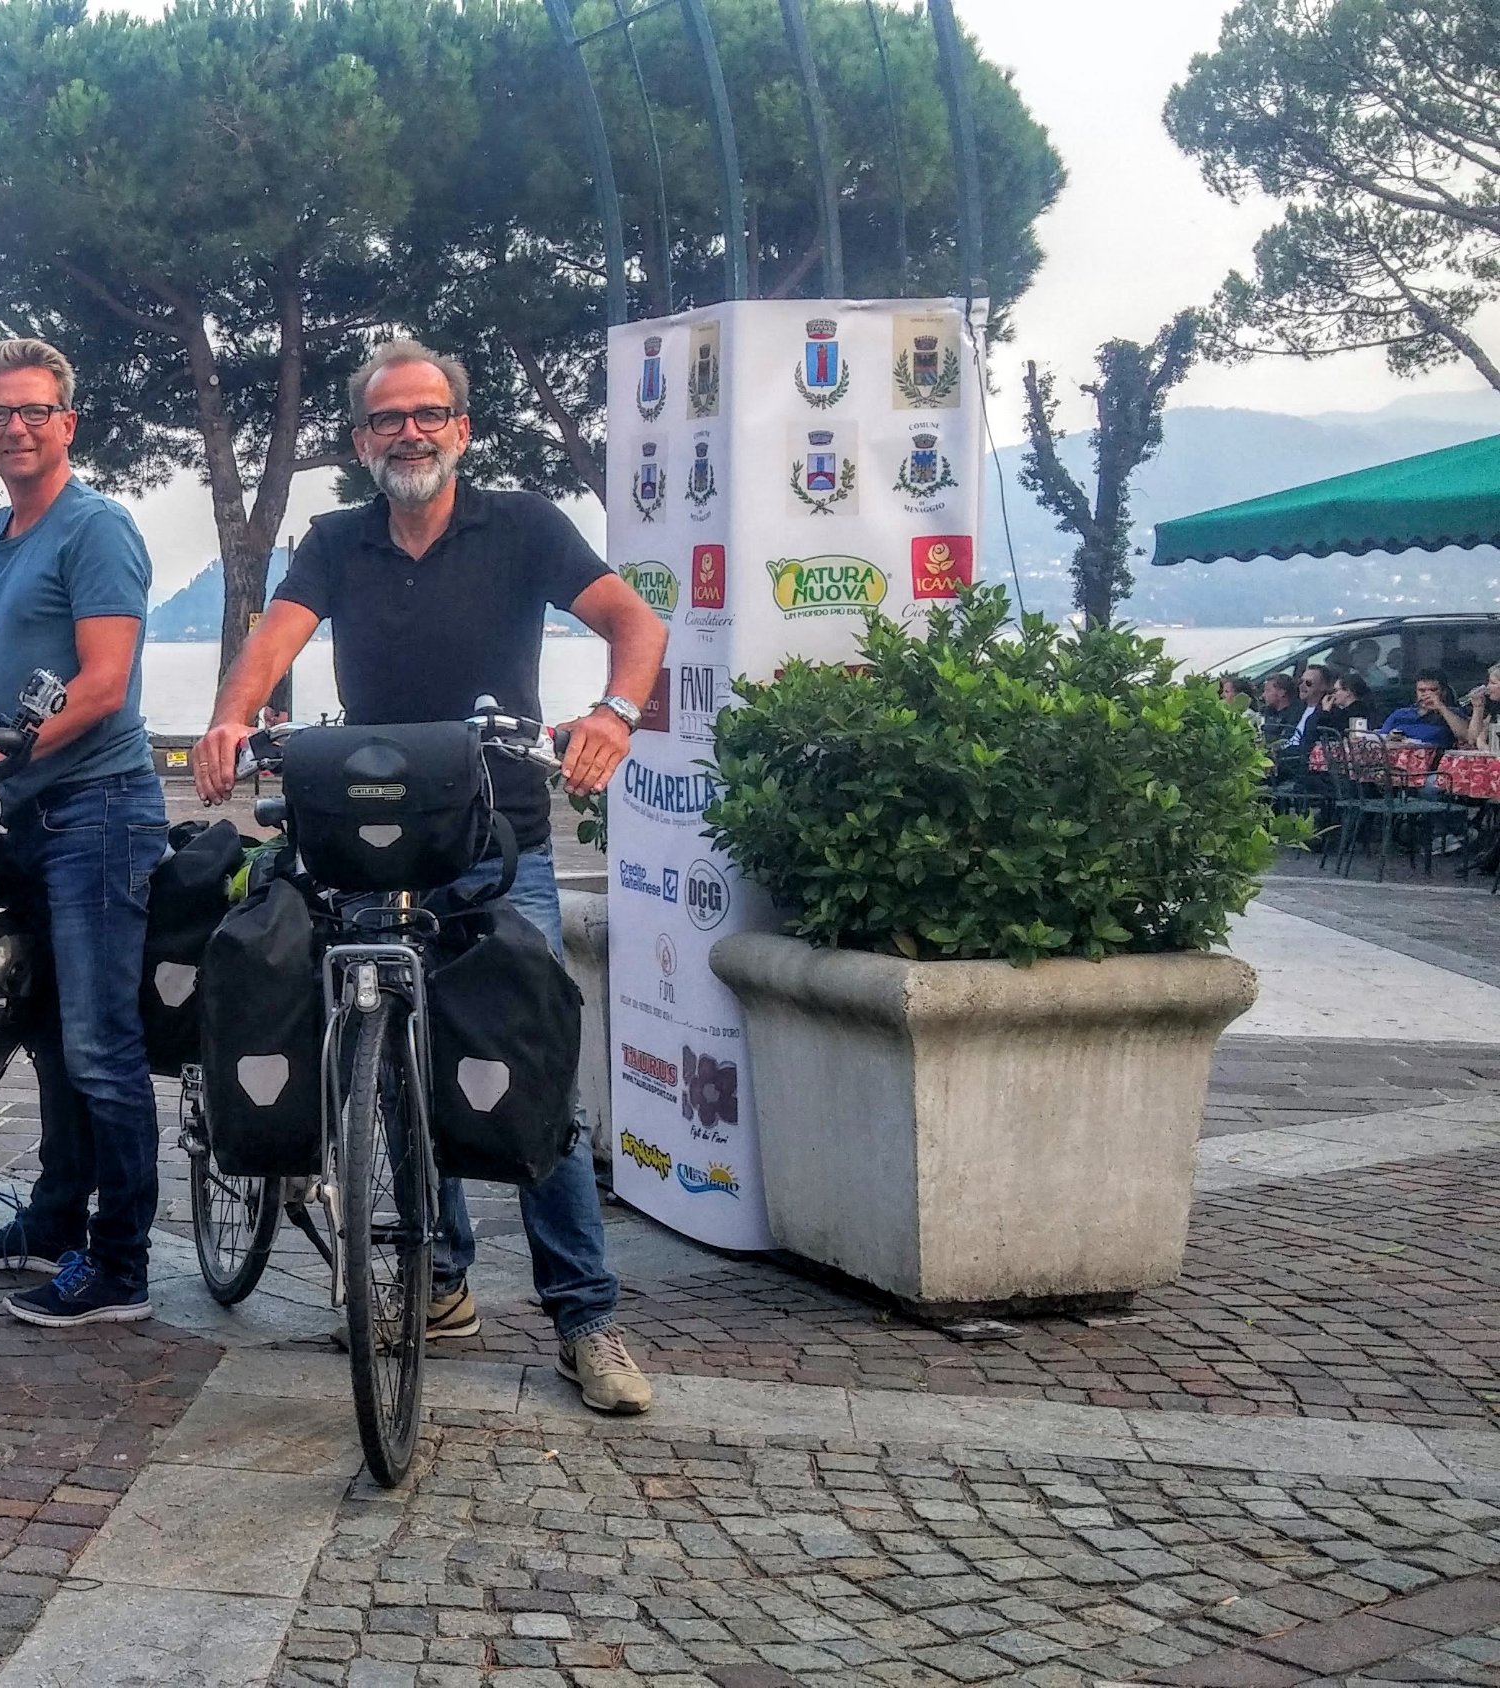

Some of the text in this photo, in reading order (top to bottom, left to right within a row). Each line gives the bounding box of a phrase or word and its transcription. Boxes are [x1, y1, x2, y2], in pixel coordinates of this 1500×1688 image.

[908, 421, 940, 431] COMUNE
[903, 502, 946, 514] MENAGGIO
[640, 589, 670, 607] UOVA
[694, 587, 720, 600] ICAM
[792, 584, 869, 606] NUOVA
[798, 608, 828, 618] MONDO
[625, 759, 717, 813] CHIARELLA
[620, 860, 646, 879] Credito
[620, 874, 661, 897] Valtellinese
[688, 877, 722, 911] DCG
[621, 1042, 678, 1087] TAURUS
